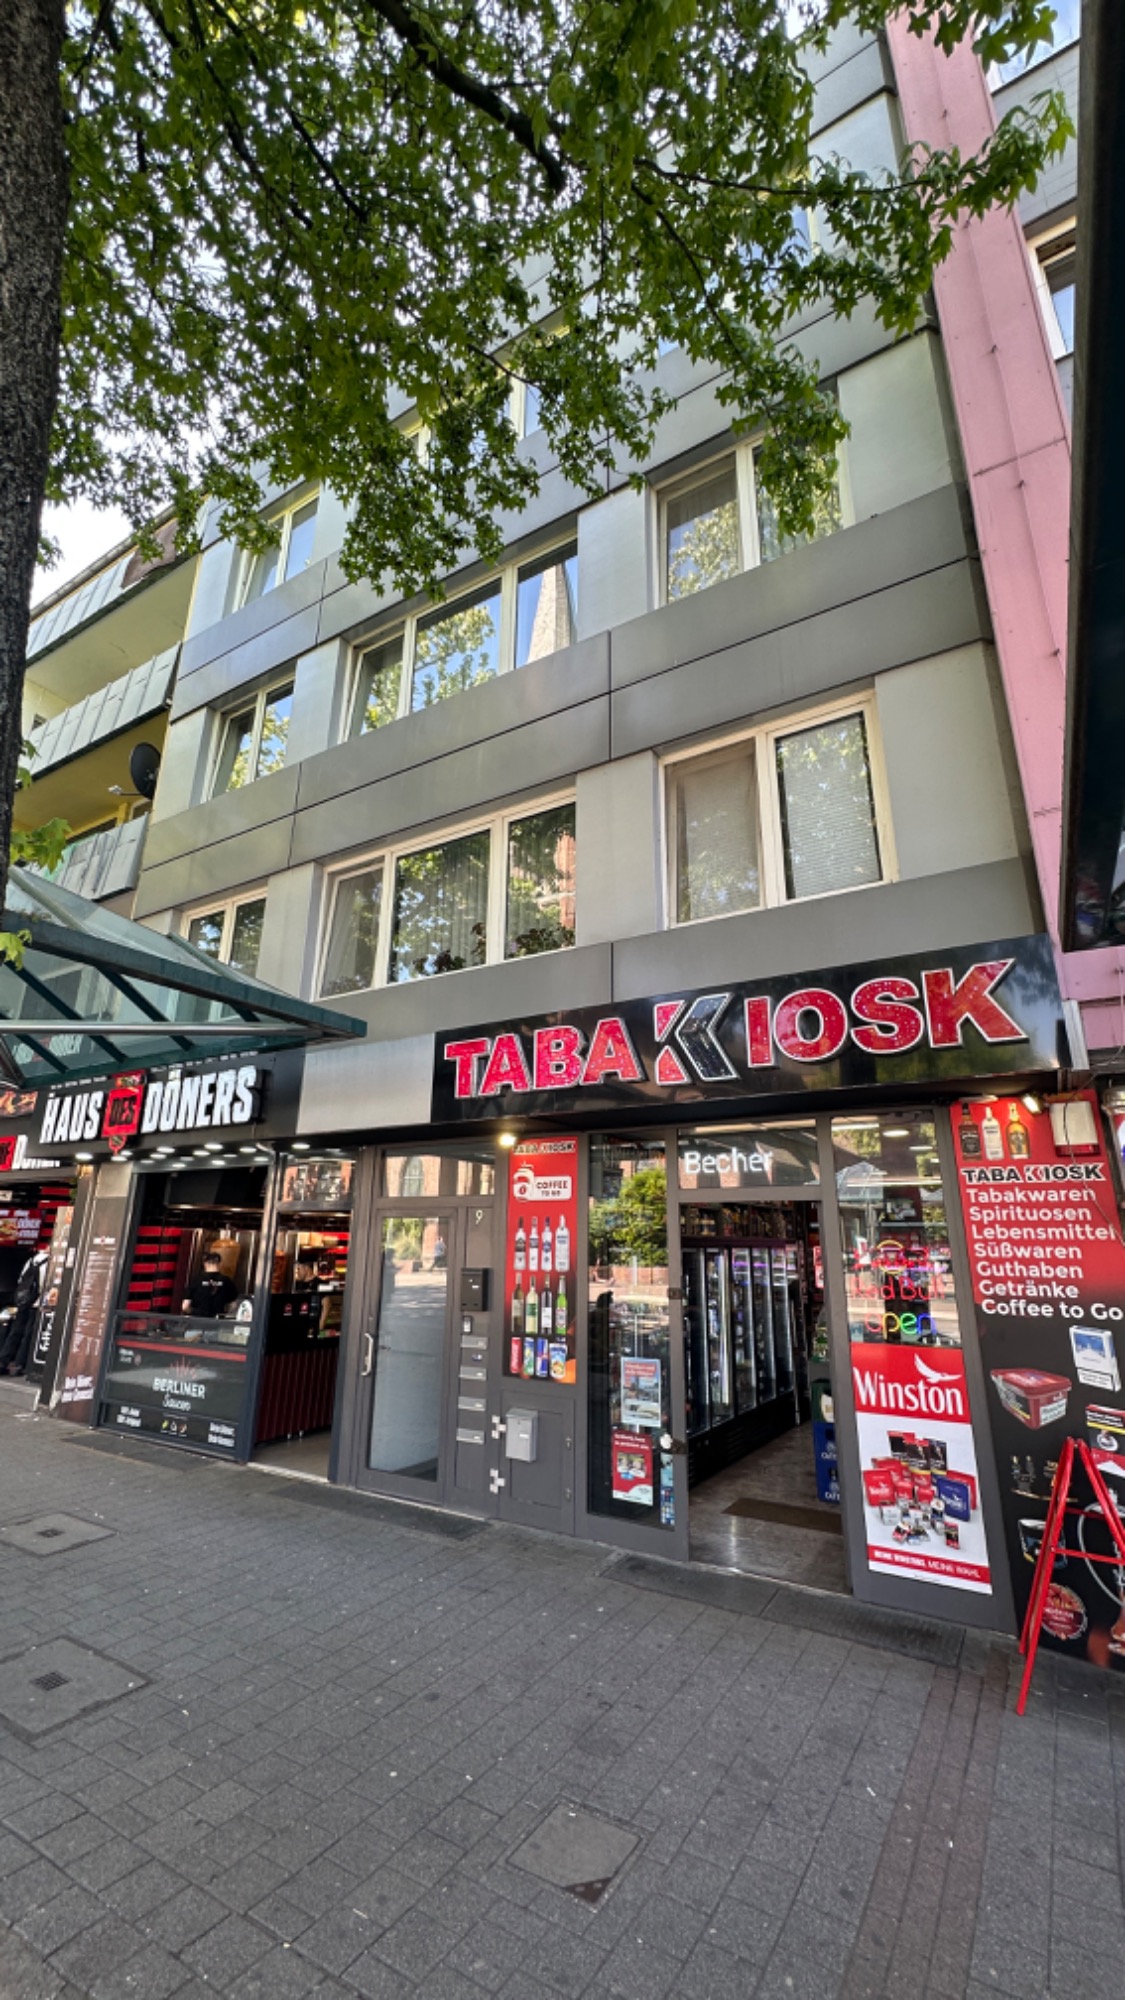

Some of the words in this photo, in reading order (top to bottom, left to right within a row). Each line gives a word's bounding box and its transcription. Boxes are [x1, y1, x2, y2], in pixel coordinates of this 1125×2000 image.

[39, 1091, 104, 1143] HAUS
[109, 1096, 136, 1126] DES
[140, 1065, 257, 1133] DÖNERS
[684, 1147, 773, 1174] Becher
[962, 1167, 1023, 1184] TABA
[1024, 1162, 1106, 1182] KIOSK
[536, 1181, 568, 1190] COFFEE
[966, 1188, 1096, 1203] Tabakwaren
[476, 1210, 483, 1224] 9
[969, 1205, 1092, 1224] Spirituosen
[972, 1224, 1116, 1240] Lebensmittel
[974, 1242, 1082, 1259] Süßwaren
[976, 1261, 1083, 1278] Guthaben
[979, 1279, 1079, 1298] Getränke
[981, 1298, 1053, 1317] Coffee
[1060, 1303, 1084, 1318] to
[1091, 1303, 1123, 1320] Go
[865, 1312, 937, 1340] open
[153, 1377, 206, 1399] BERLINER
[853, 1365, 963, 1416] Winston
